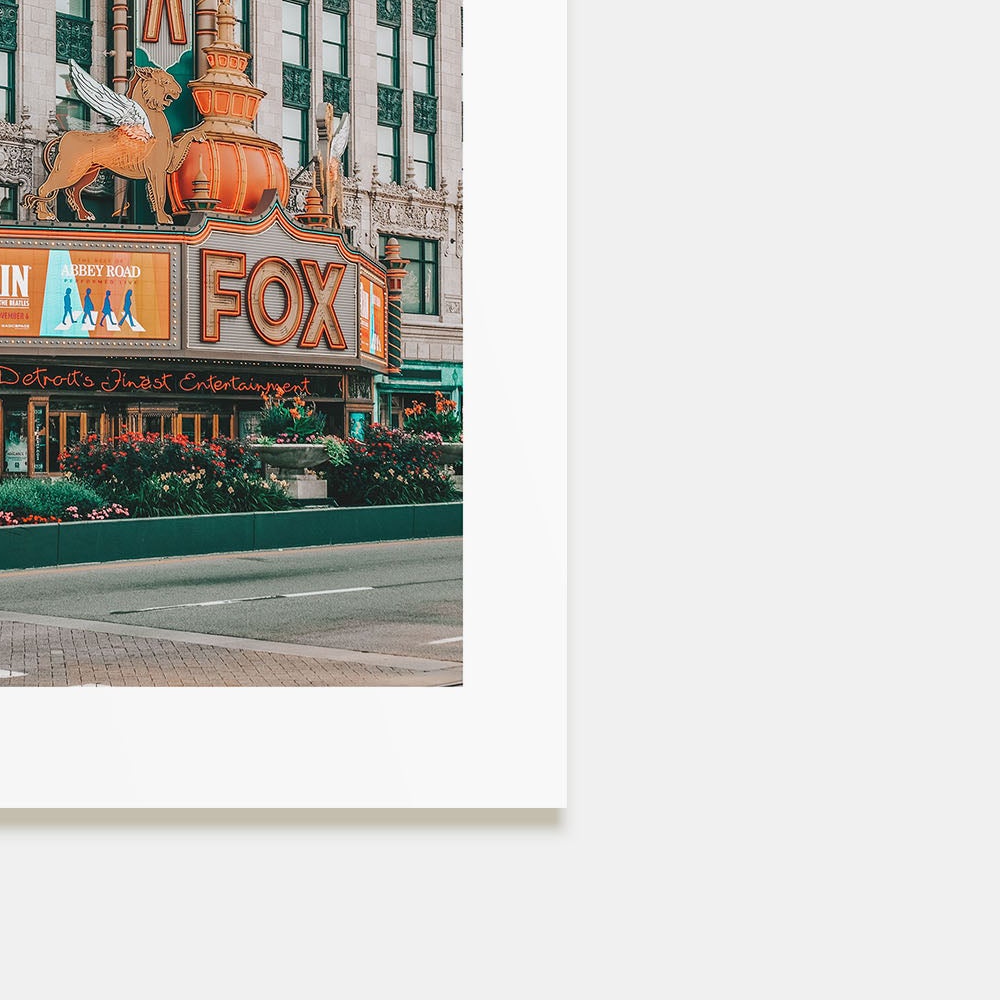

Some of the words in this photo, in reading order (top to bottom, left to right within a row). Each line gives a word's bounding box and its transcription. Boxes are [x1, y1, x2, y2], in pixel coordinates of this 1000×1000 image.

[61, 263, 103, 277] ABBEY
[106, 265, 141, 278] ROAD
[9, 299, 30, 307] BEATLES
[200, 248, 348, 350] FOX
[100, 368, 173, 393] Finest
[179, 372, 312, 396] Entertainment
